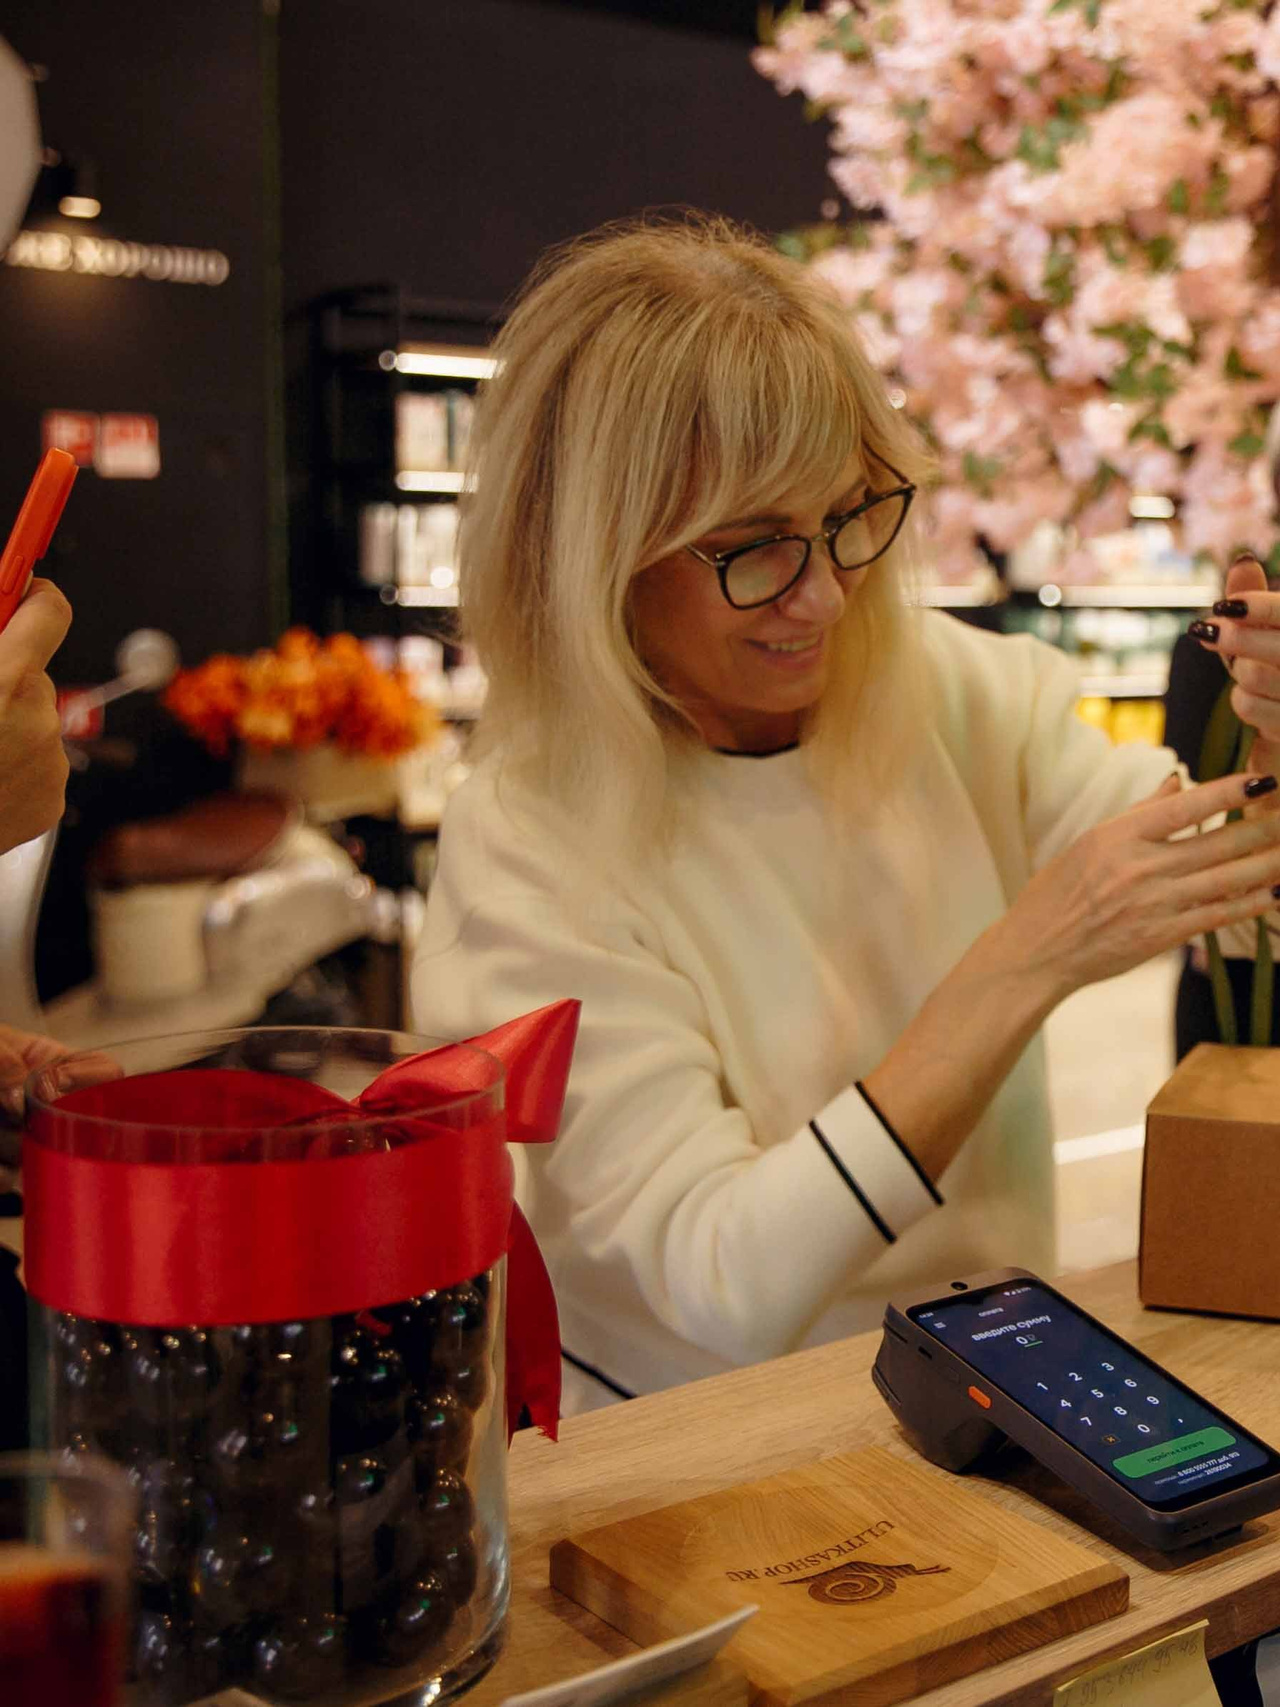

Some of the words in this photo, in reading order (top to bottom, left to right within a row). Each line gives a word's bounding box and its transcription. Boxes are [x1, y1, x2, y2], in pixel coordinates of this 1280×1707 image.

[971, 1324, 1018, 1342] введите
[1017, 1314, 1052, 1330] сумму
[1036, 1382, 1049, 1391] 1
[1068, 1372, 1083, 1382] 2
[1101, 1362, 1115, 1371] 3
[1060, 1399, 1072, 1408] 4
[1090, 1389, 1104, 1398] 5
[1124, 1378, 1137, 1388] 6
[1080, 1416, 1092, 1426] 7
[1114, 1406, 1127, 1416] 8
[1146, 1396, 1160, 1405] 9
[1137, 1424, 1150, 1433] 0
[725, 1520, 895, 1583] ULITKASHOP.RU
